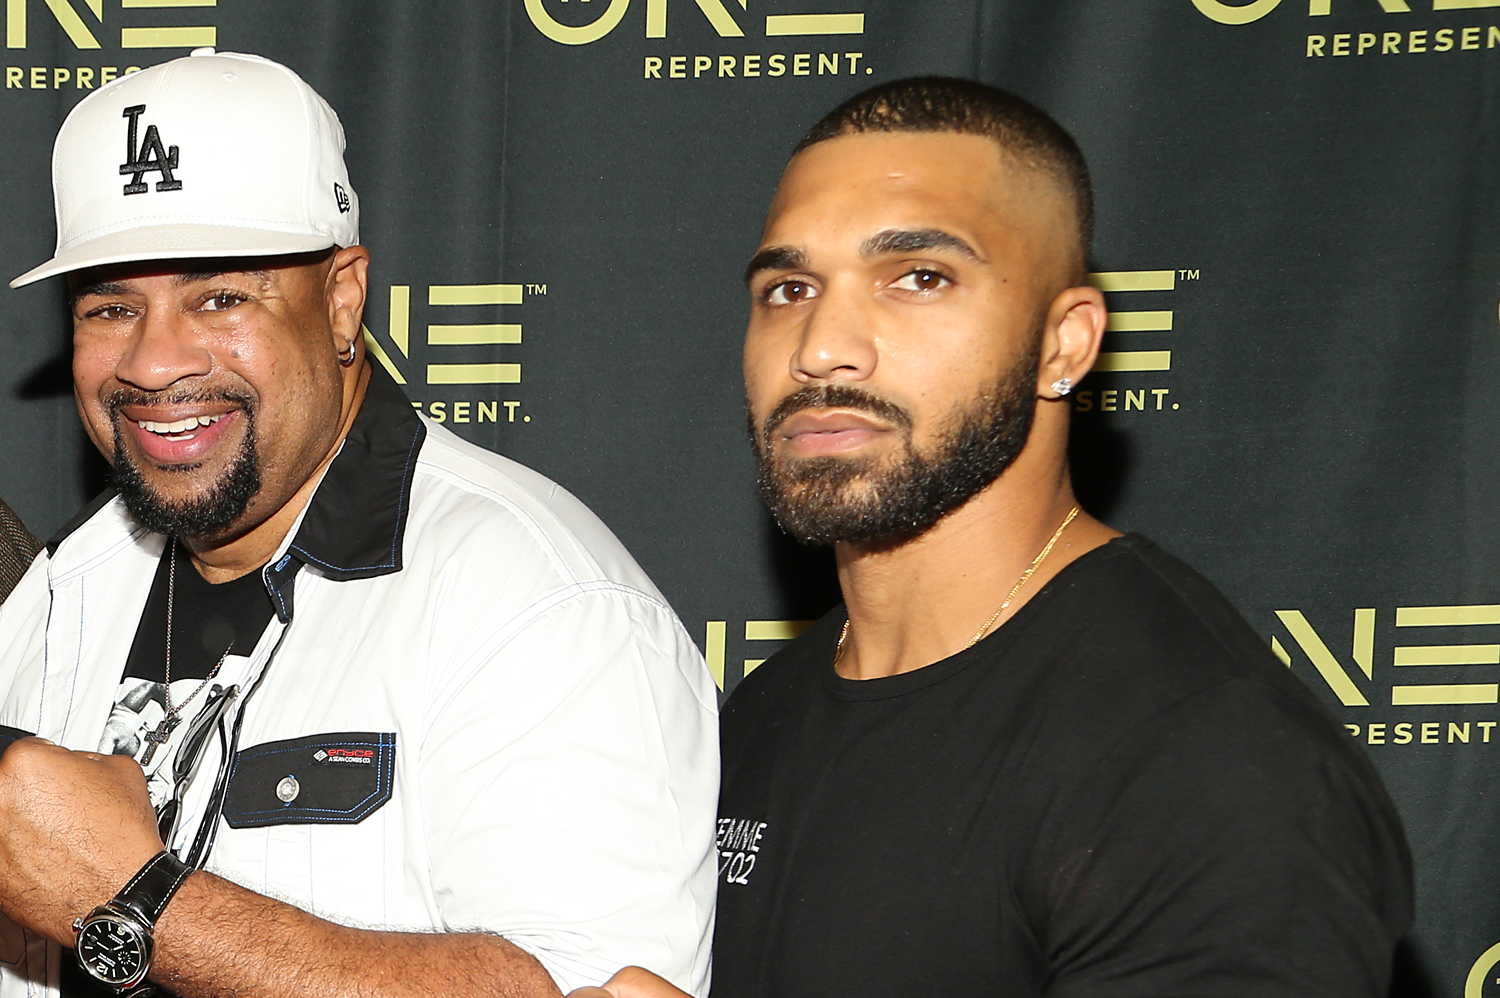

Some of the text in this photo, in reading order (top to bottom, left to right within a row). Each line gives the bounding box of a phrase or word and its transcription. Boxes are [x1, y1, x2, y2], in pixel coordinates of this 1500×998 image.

[644, 52, 874, 79] REPRESENT.
[119, 104, 182, 195] LA
[1271, 604, 1500, 707] NE
[717, 849, 756, 885] 702
